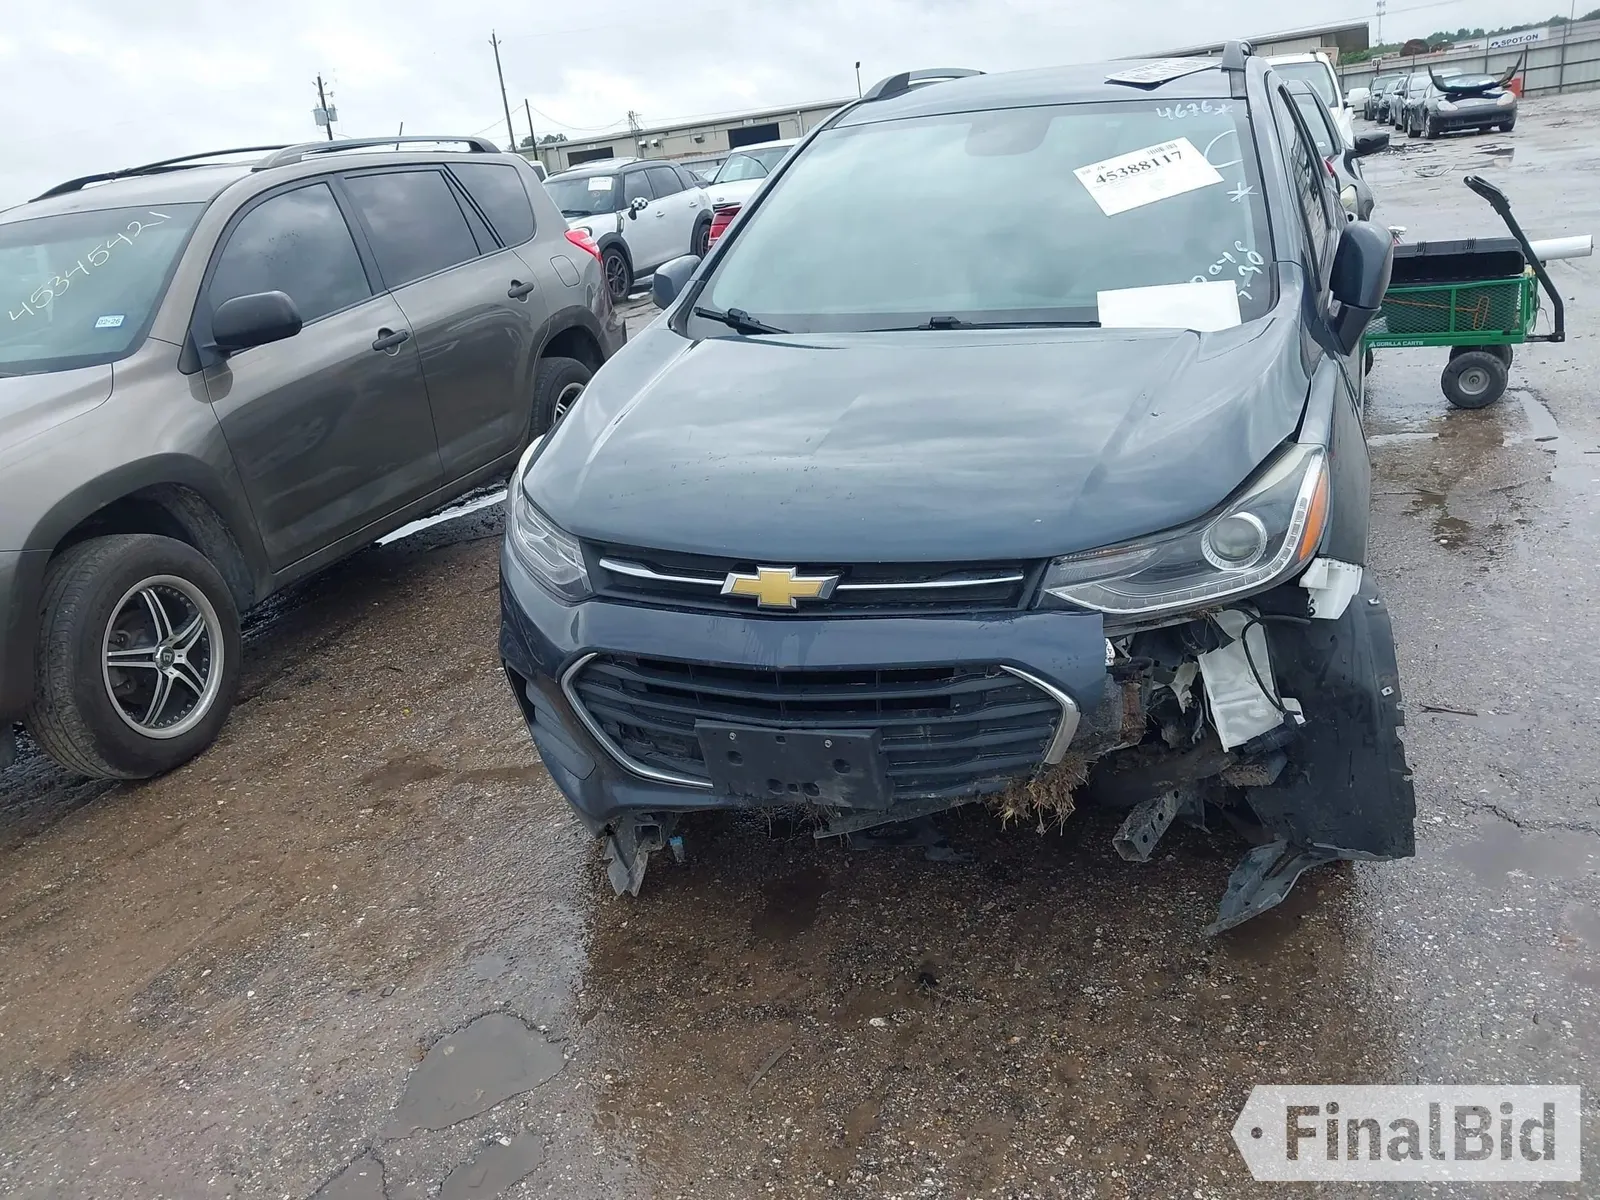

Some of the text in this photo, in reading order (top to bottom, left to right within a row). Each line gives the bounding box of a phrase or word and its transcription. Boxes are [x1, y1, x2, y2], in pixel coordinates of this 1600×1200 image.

[1500, 33, 1539, 46] SPOT-ON
[1095, 150, 1183, 183] 45388117
[8, 211, 172, 321] 45345421
